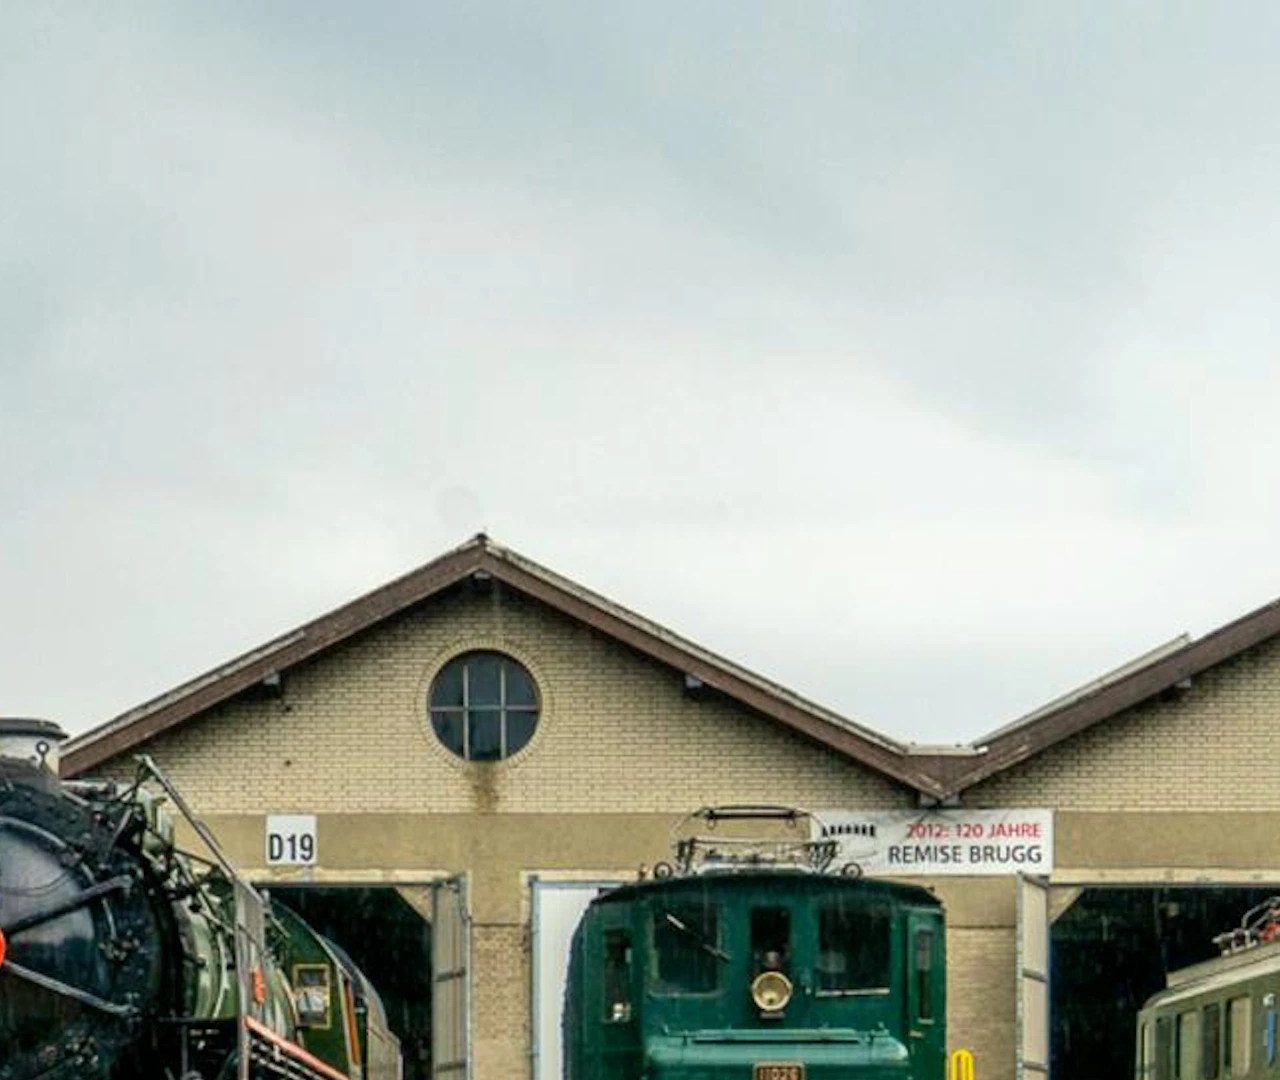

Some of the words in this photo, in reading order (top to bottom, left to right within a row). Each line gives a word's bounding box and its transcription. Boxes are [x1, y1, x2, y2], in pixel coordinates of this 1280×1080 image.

[906, 823, 949, 838] 2012:
[956, 823, 983, 838] 120
[988, 823, 1041, 838] JAHRE
[269, 833, 313, 861] D19
[888, 845, 962, 863] REMISE
[970, 845, 1042, 864] BRUGG
